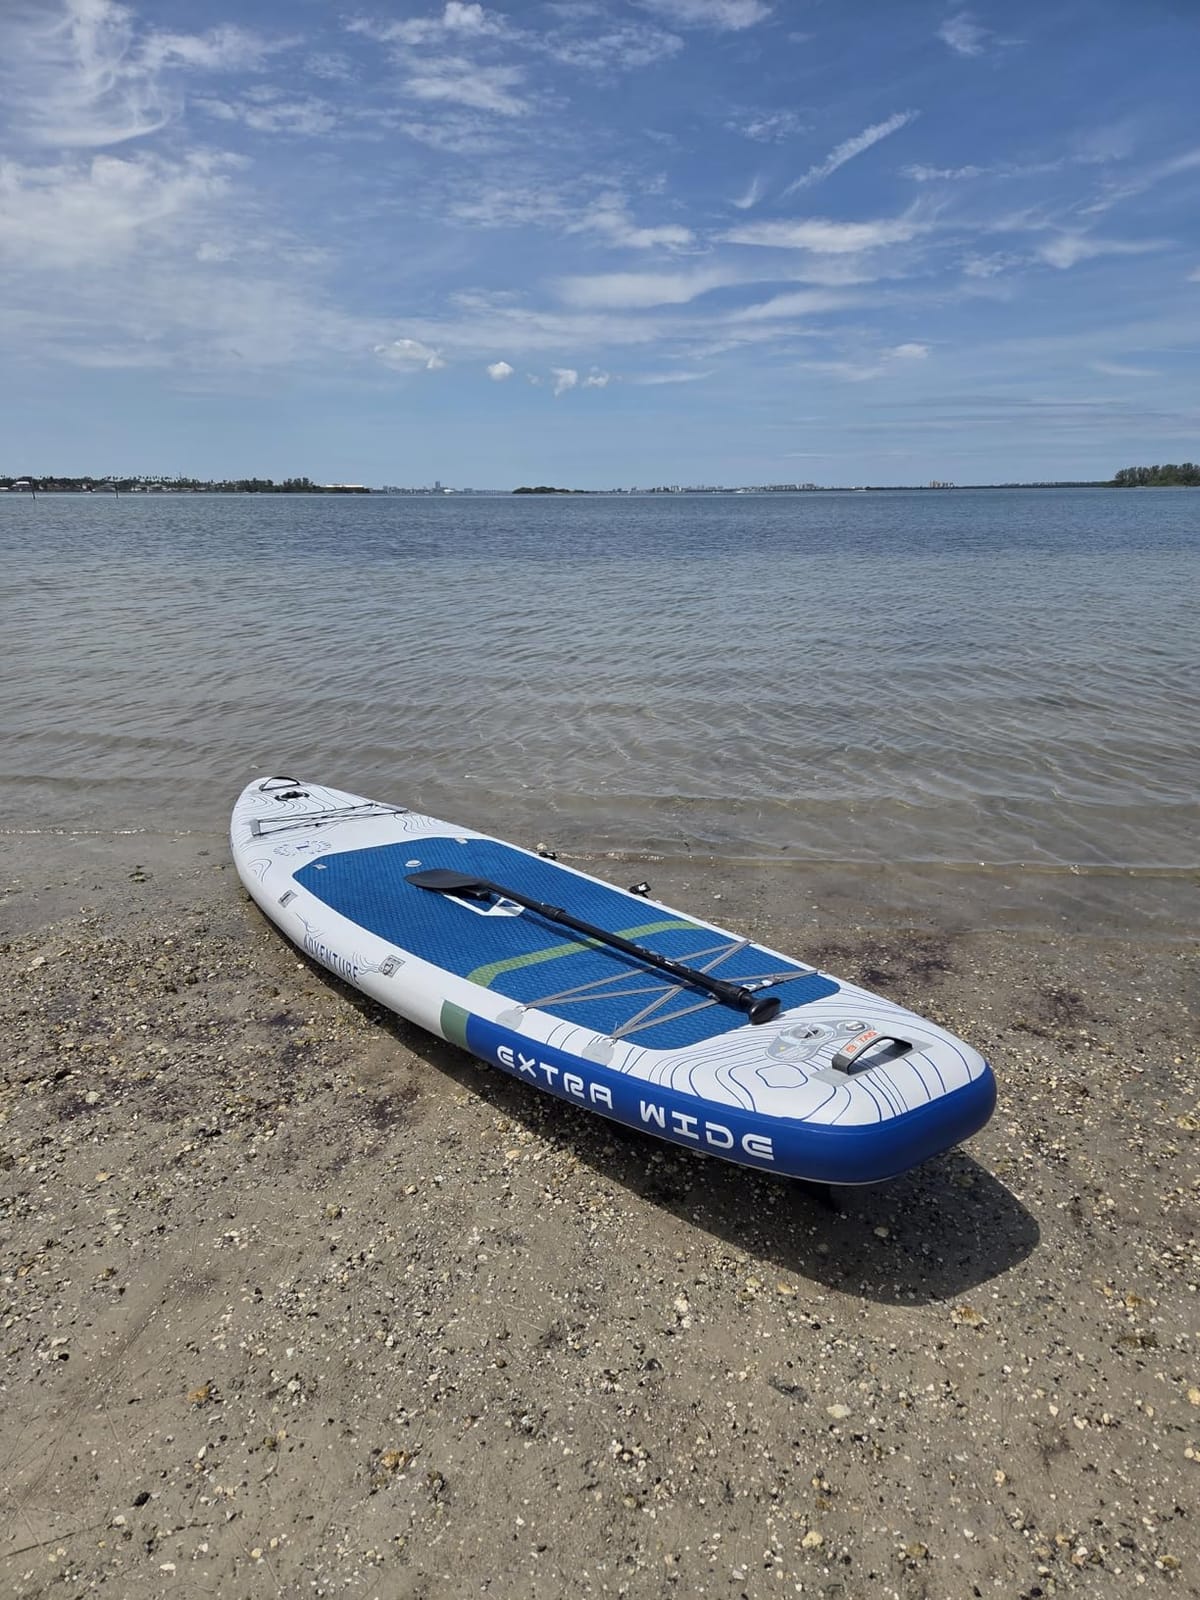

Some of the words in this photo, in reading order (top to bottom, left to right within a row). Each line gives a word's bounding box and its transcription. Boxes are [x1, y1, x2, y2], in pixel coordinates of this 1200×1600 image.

[303, 933, 361, 985] ADVENTURE
[496, 1045, 614, 1110] EXTRA
[639, 1099, 775, 1161] WIDE
